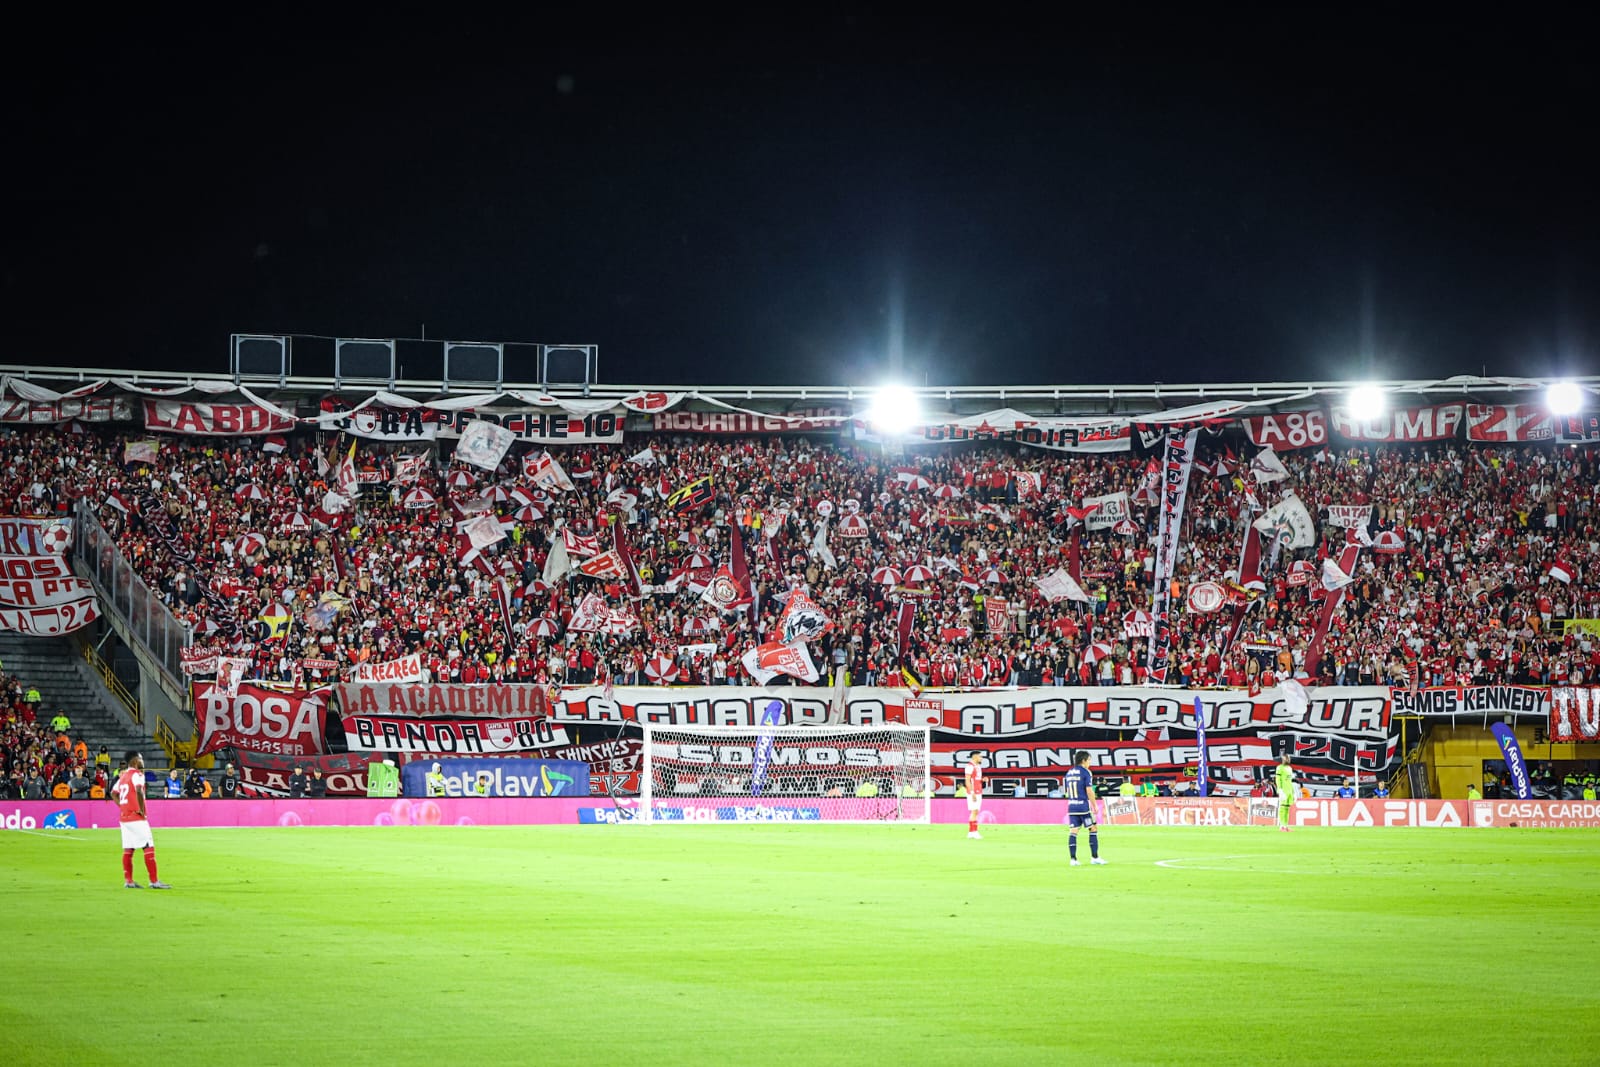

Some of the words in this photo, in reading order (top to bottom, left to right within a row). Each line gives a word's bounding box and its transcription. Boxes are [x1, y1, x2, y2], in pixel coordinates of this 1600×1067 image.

[584, 413, 617, 438] 10
[338, 684, 379, 719] LA
[388, 684, 547, 716] ACADEMIA
[552, 695, 623, 721] LA
[906, 700, 930, 709] SANTA
[1393, 690, 1457, 712] SOMOS
[1464, 686, 1548, 713] KENNEDY
[197, 686, 326, 755] BOSA
[355, 718, 484, 753] BANDA
[514, 719, 555, 748] 80
[1067, 781, 1079, 799] 11
[1154, 807, 1231, 826] NECTAR
[1295, 801, 1373, 827] FILA
[1384, 801, 1461, 827] FILA
[1498, 803, 1545, 818] CASA
